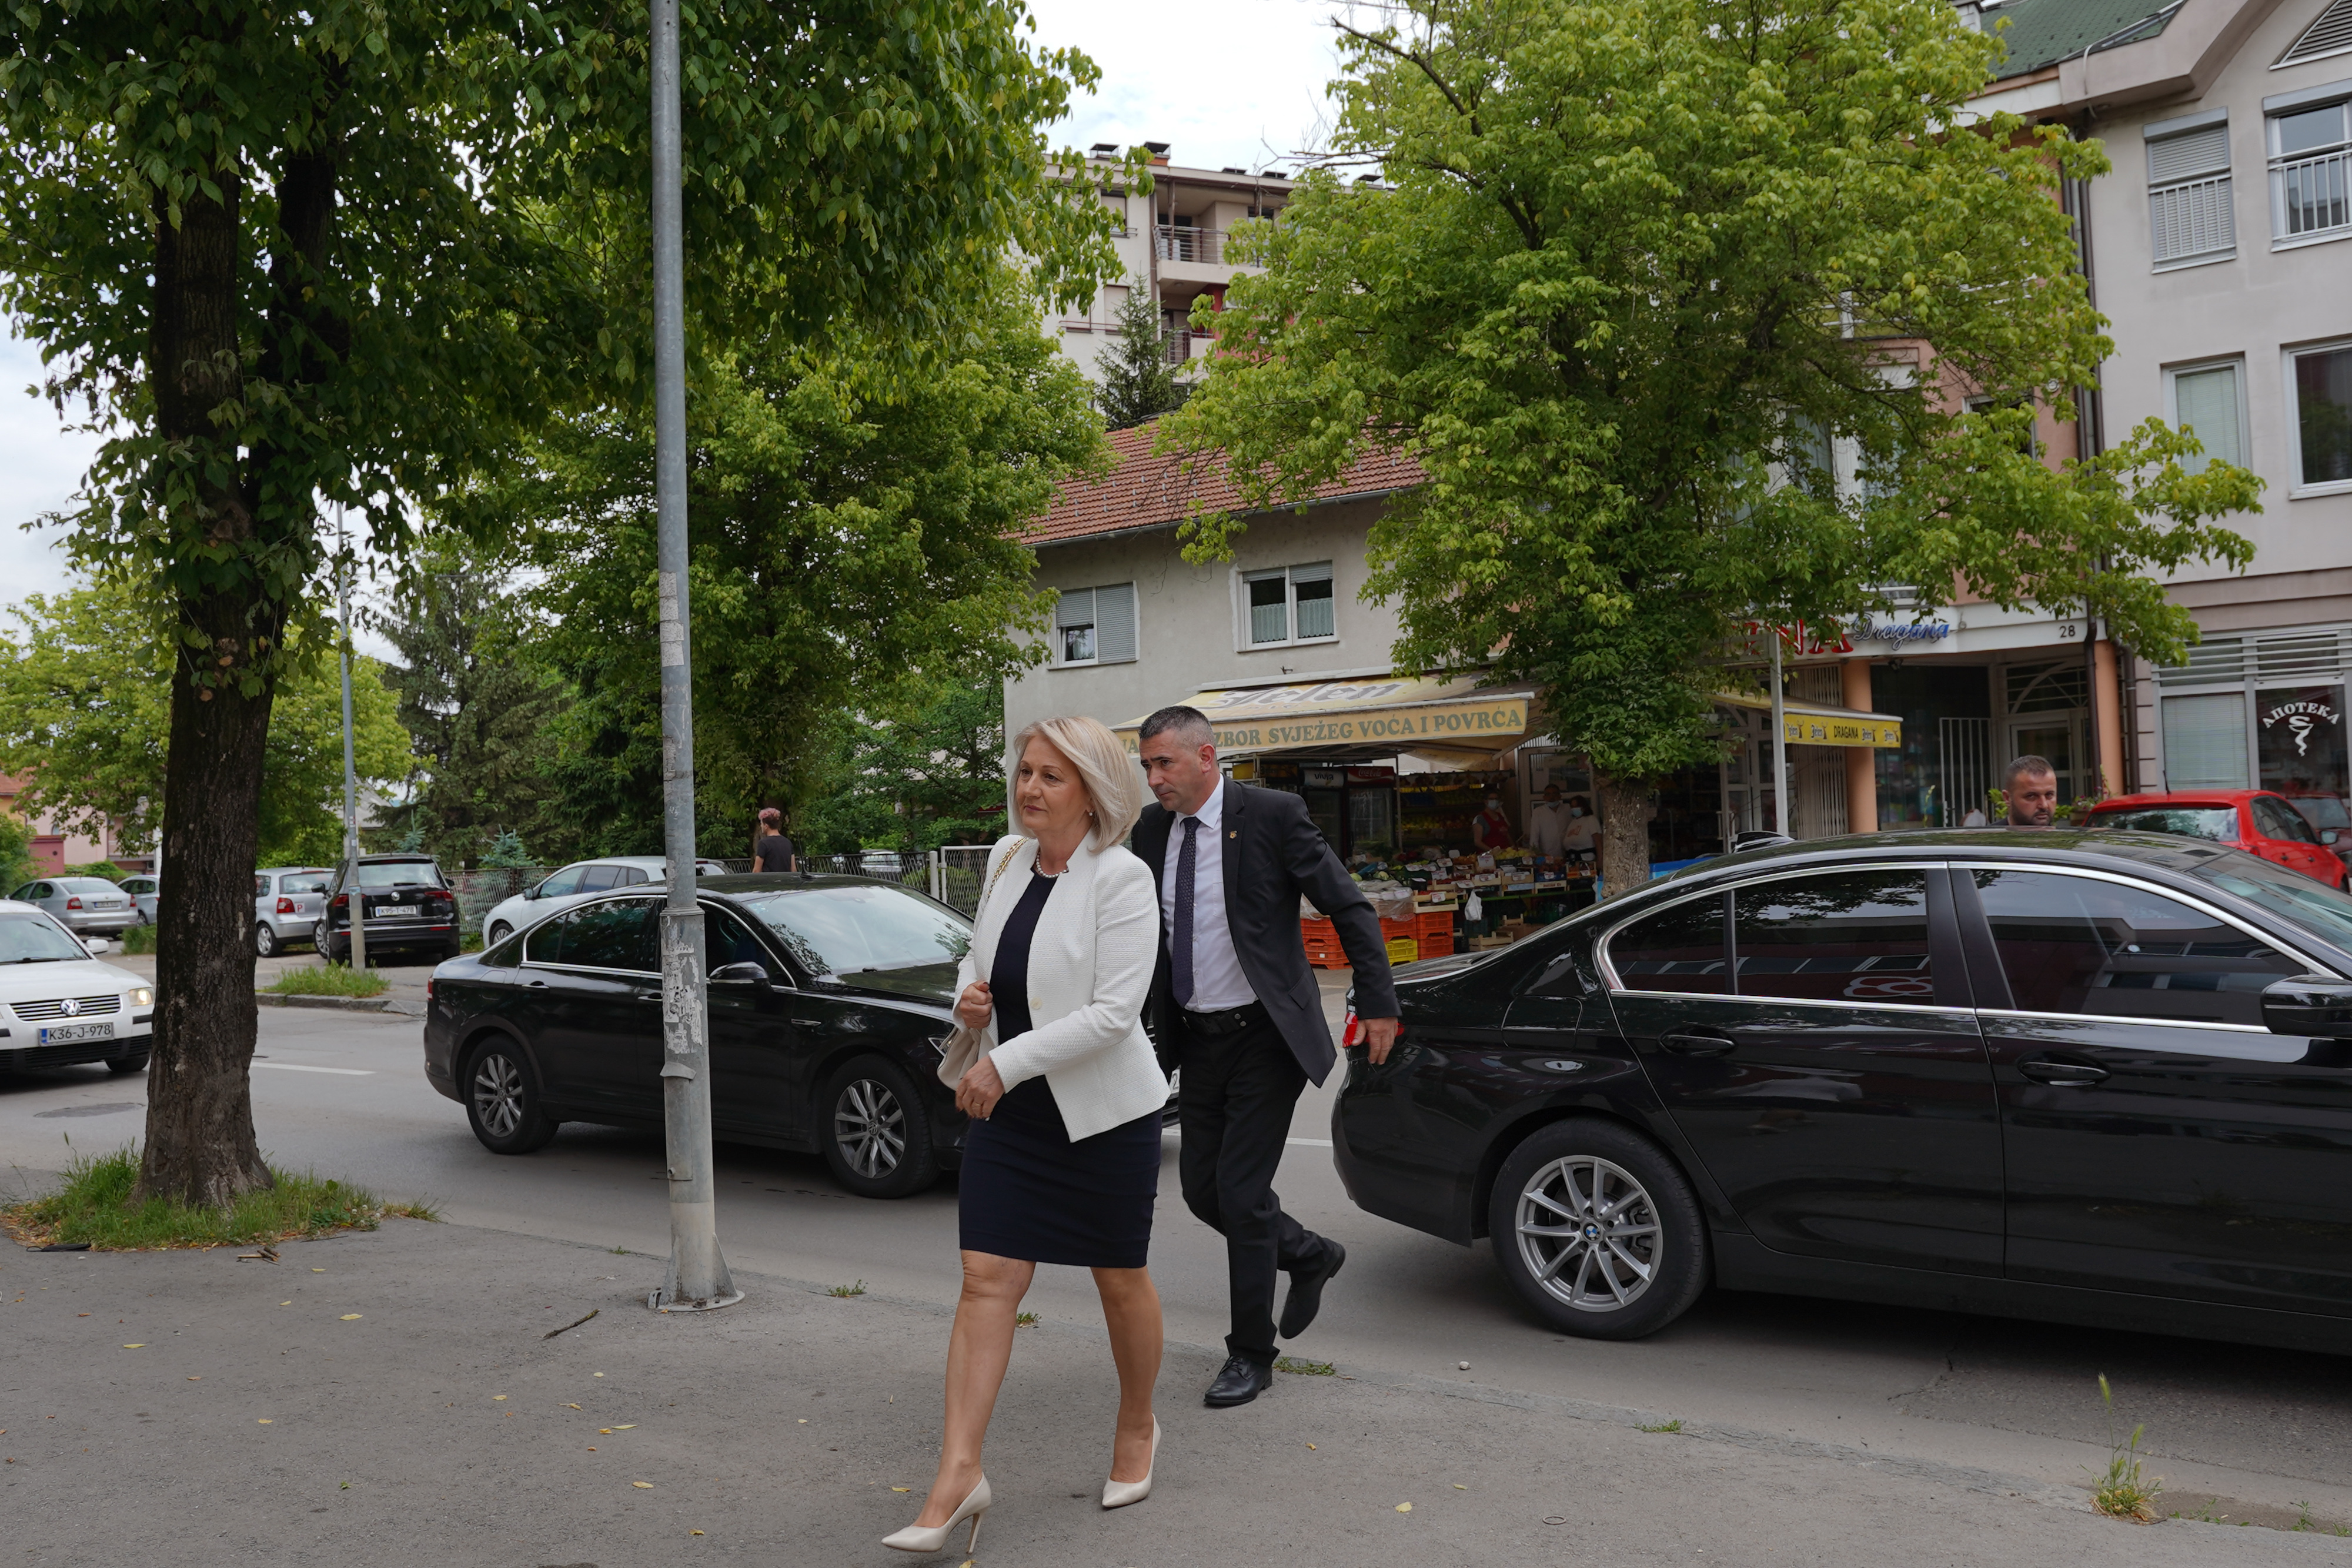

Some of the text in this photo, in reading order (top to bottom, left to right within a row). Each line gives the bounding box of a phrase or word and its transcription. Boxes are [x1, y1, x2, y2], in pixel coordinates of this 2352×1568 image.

[1853, 613, 1949, 651] Dragana
[2059, 625, 2076, 638] 28
[2263, 702, 2340, 728] АПОТЕКА
[1214, 706, 1523, 747] ZBOR SVJEŽEG VOĆA I POVRĆA
[1834, 726, 1858, 739] DRAGANA
[49, 1024, 111, 1040] K36-J-978
